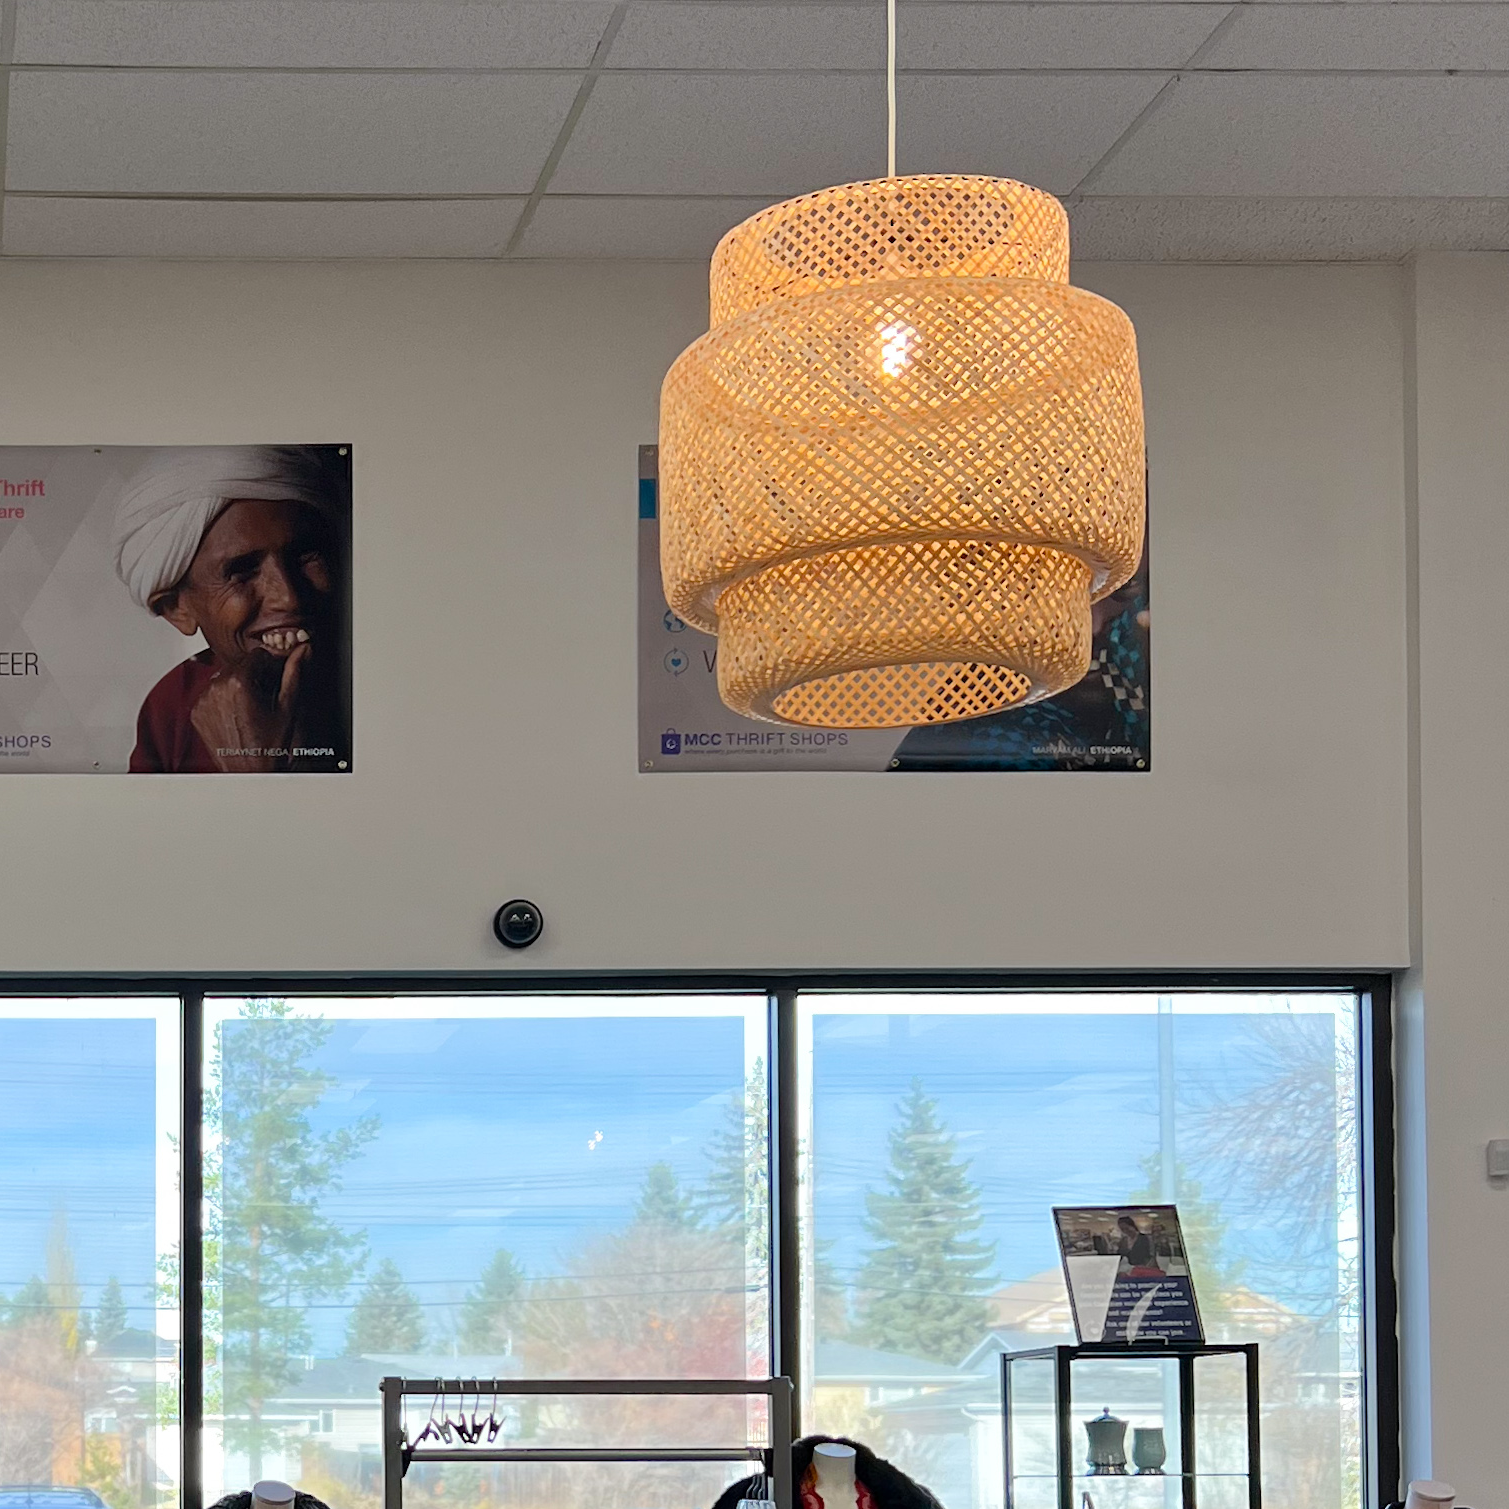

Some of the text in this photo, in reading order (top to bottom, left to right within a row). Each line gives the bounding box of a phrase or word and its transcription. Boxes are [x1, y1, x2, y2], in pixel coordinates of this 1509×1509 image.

[684, 732, 848, 746] MCC THRIFT SHOPS
[292, 747, 335, 756] ETHIOPIA
[1090, 746, 1132, 754] ETHIOPIA
